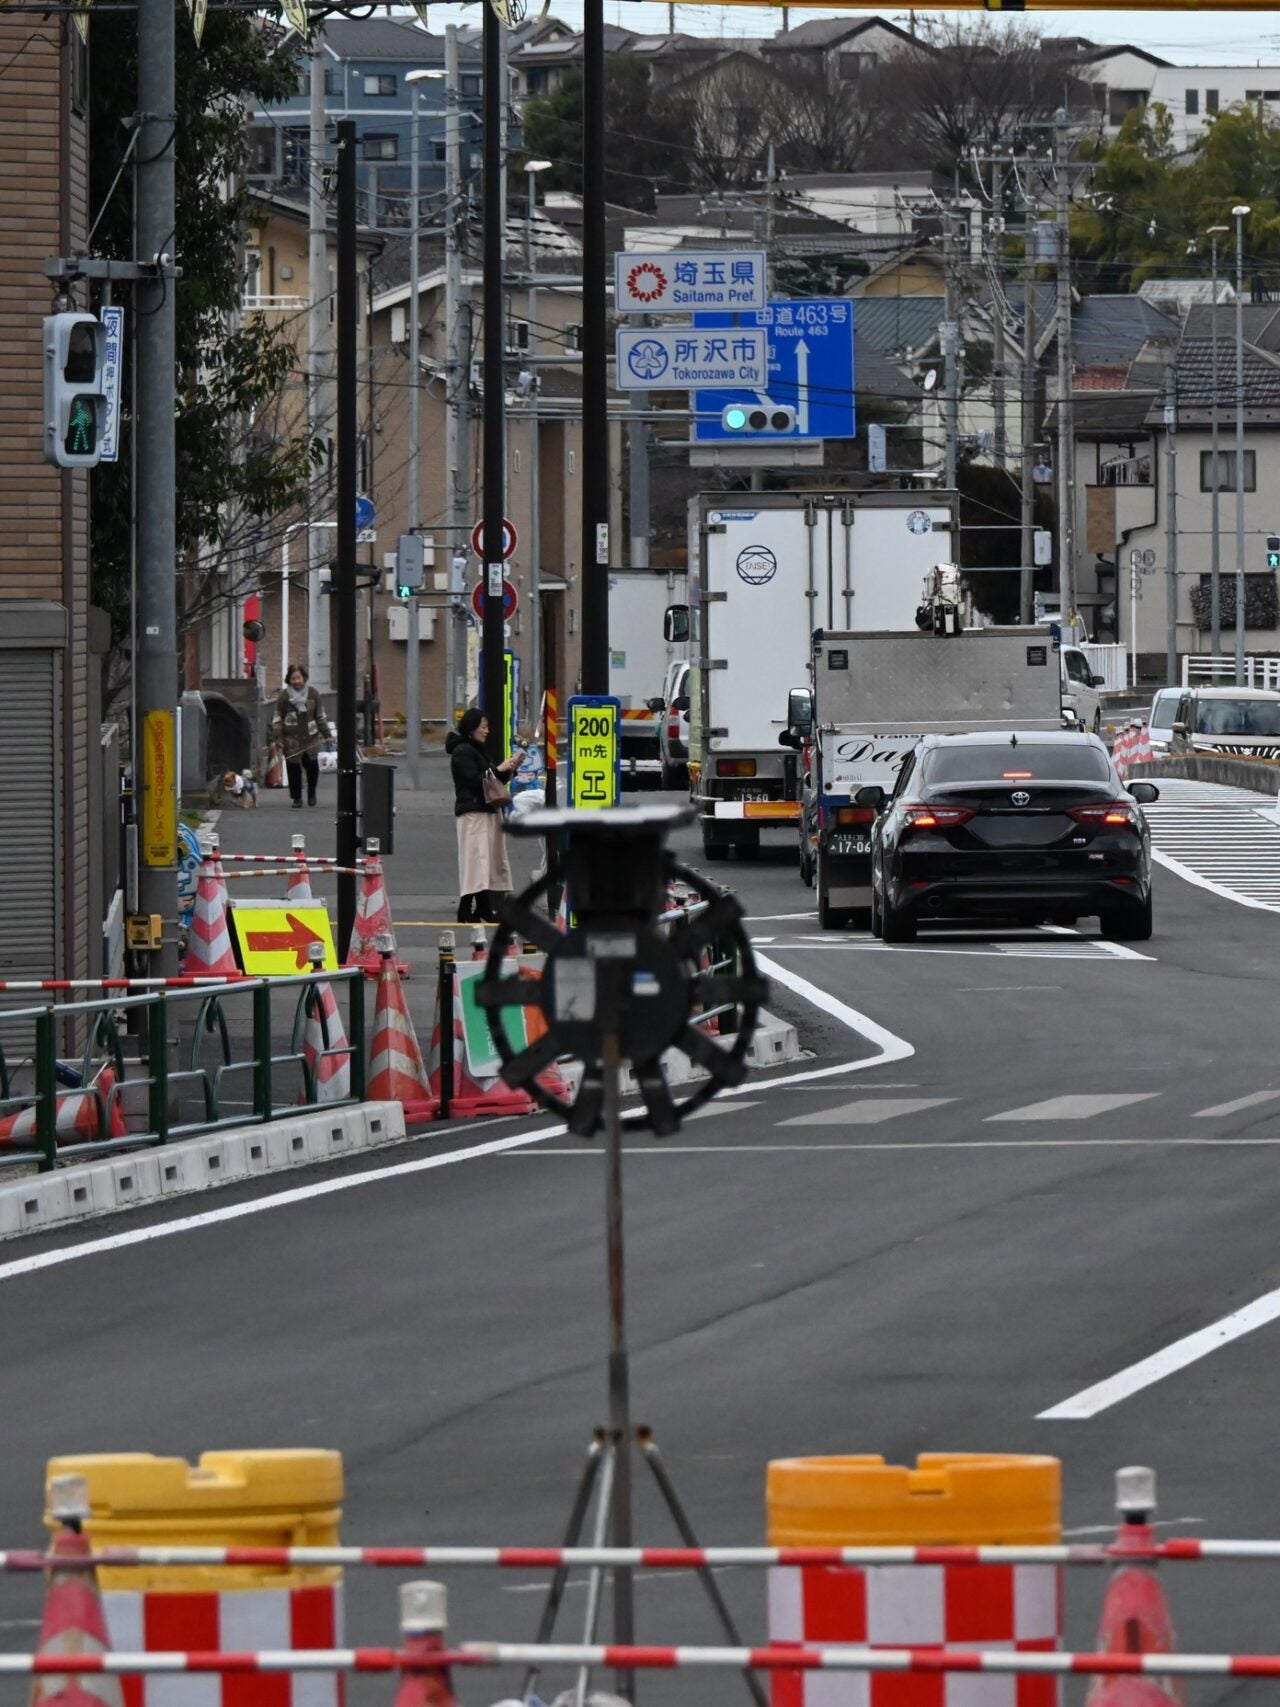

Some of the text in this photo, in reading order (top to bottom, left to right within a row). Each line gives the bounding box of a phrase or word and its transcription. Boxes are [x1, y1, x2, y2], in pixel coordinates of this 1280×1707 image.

[673, 261, 755, 286] 埼玉県
[673, 289, 757, 303] Saitama Pref.
[756, 305, 847, 325] 国道463号
[775, 326, 829, 337] Route 463
[674, 337, 756, 363] 所沢市
[672, 367, 736, 380] Tokorozawa
[739, 366, 760, 382] City
[103, 315, 118, 453] 夜間押ボタン式
[579, 717, 609, 737] 200
[579, 744, 607, 758] m先
[839, 841, 871, 853] 17-06
